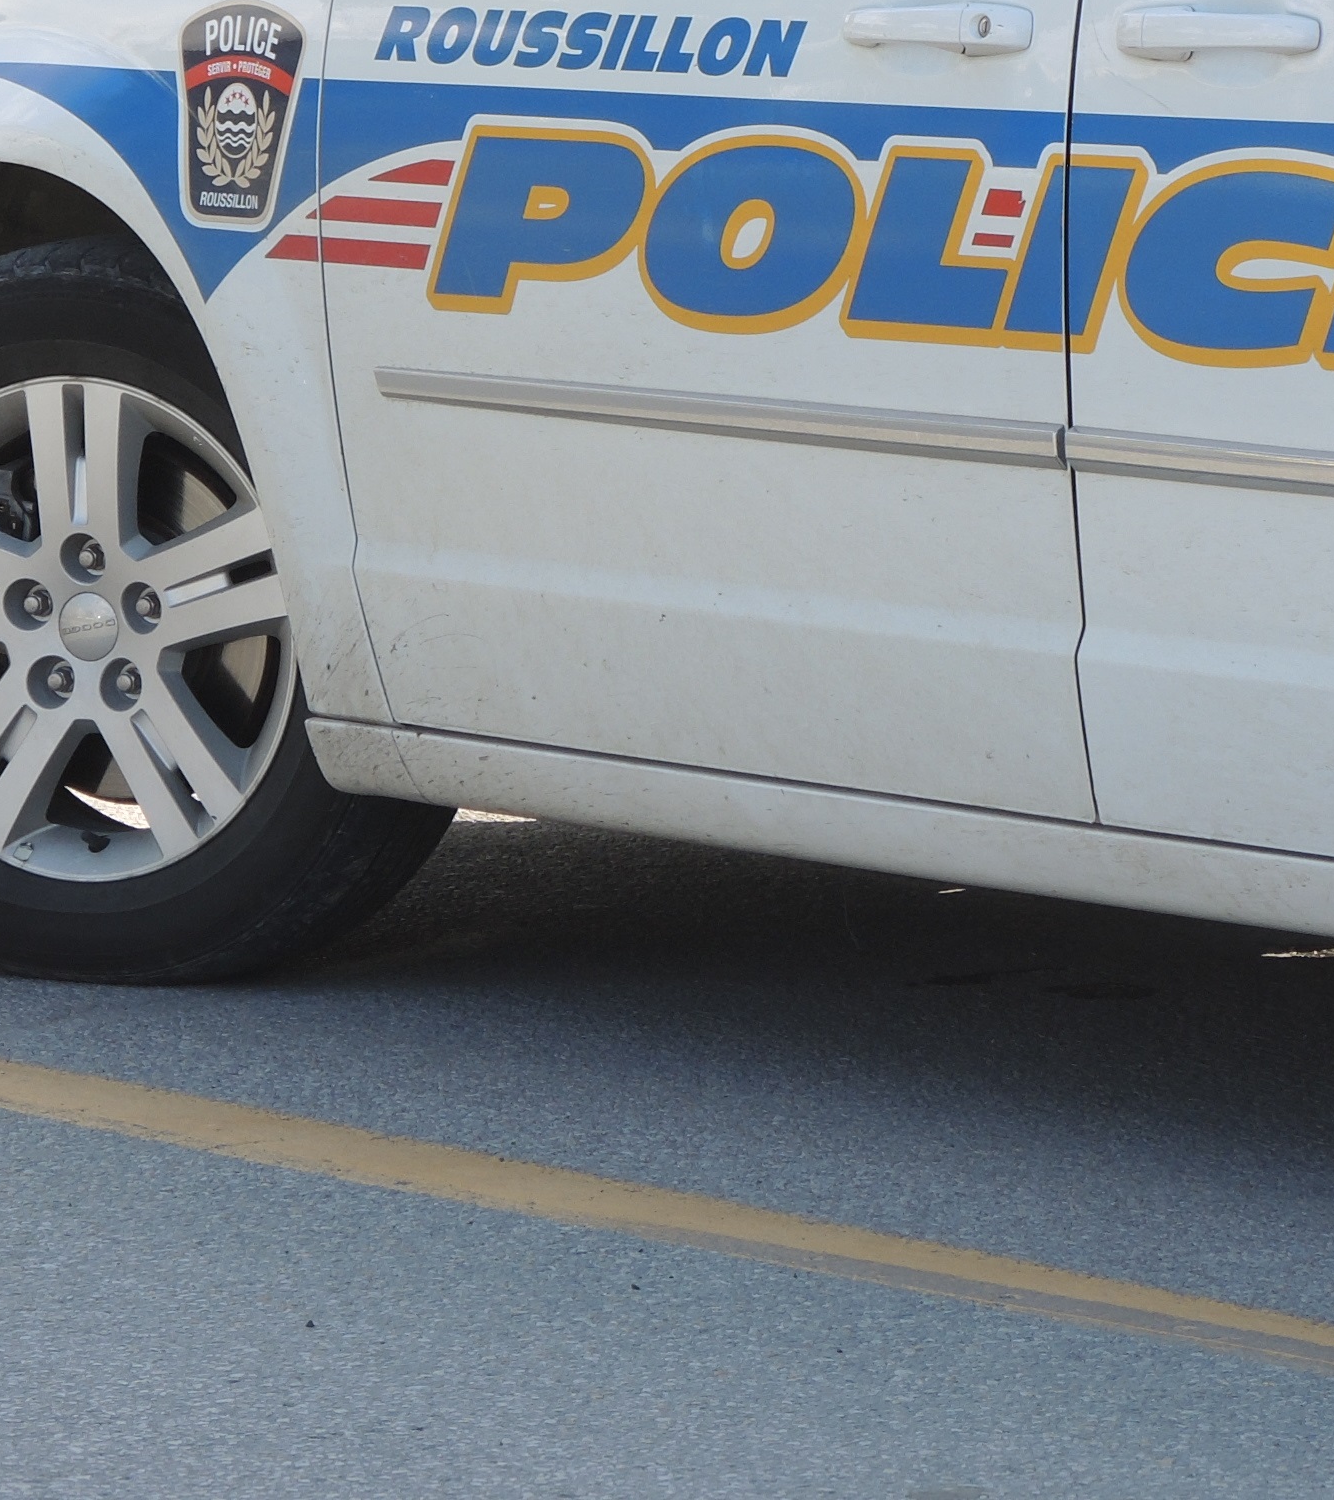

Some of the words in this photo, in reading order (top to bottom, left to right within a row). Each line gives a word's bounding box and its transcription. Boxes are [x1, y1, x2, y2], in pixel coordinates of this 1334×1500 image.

[205, 15, 282, 60] POLICE
[375, 5, 808, 79] ROUSSILLON
[199, 191, 259, 210] ROUSSILLON
